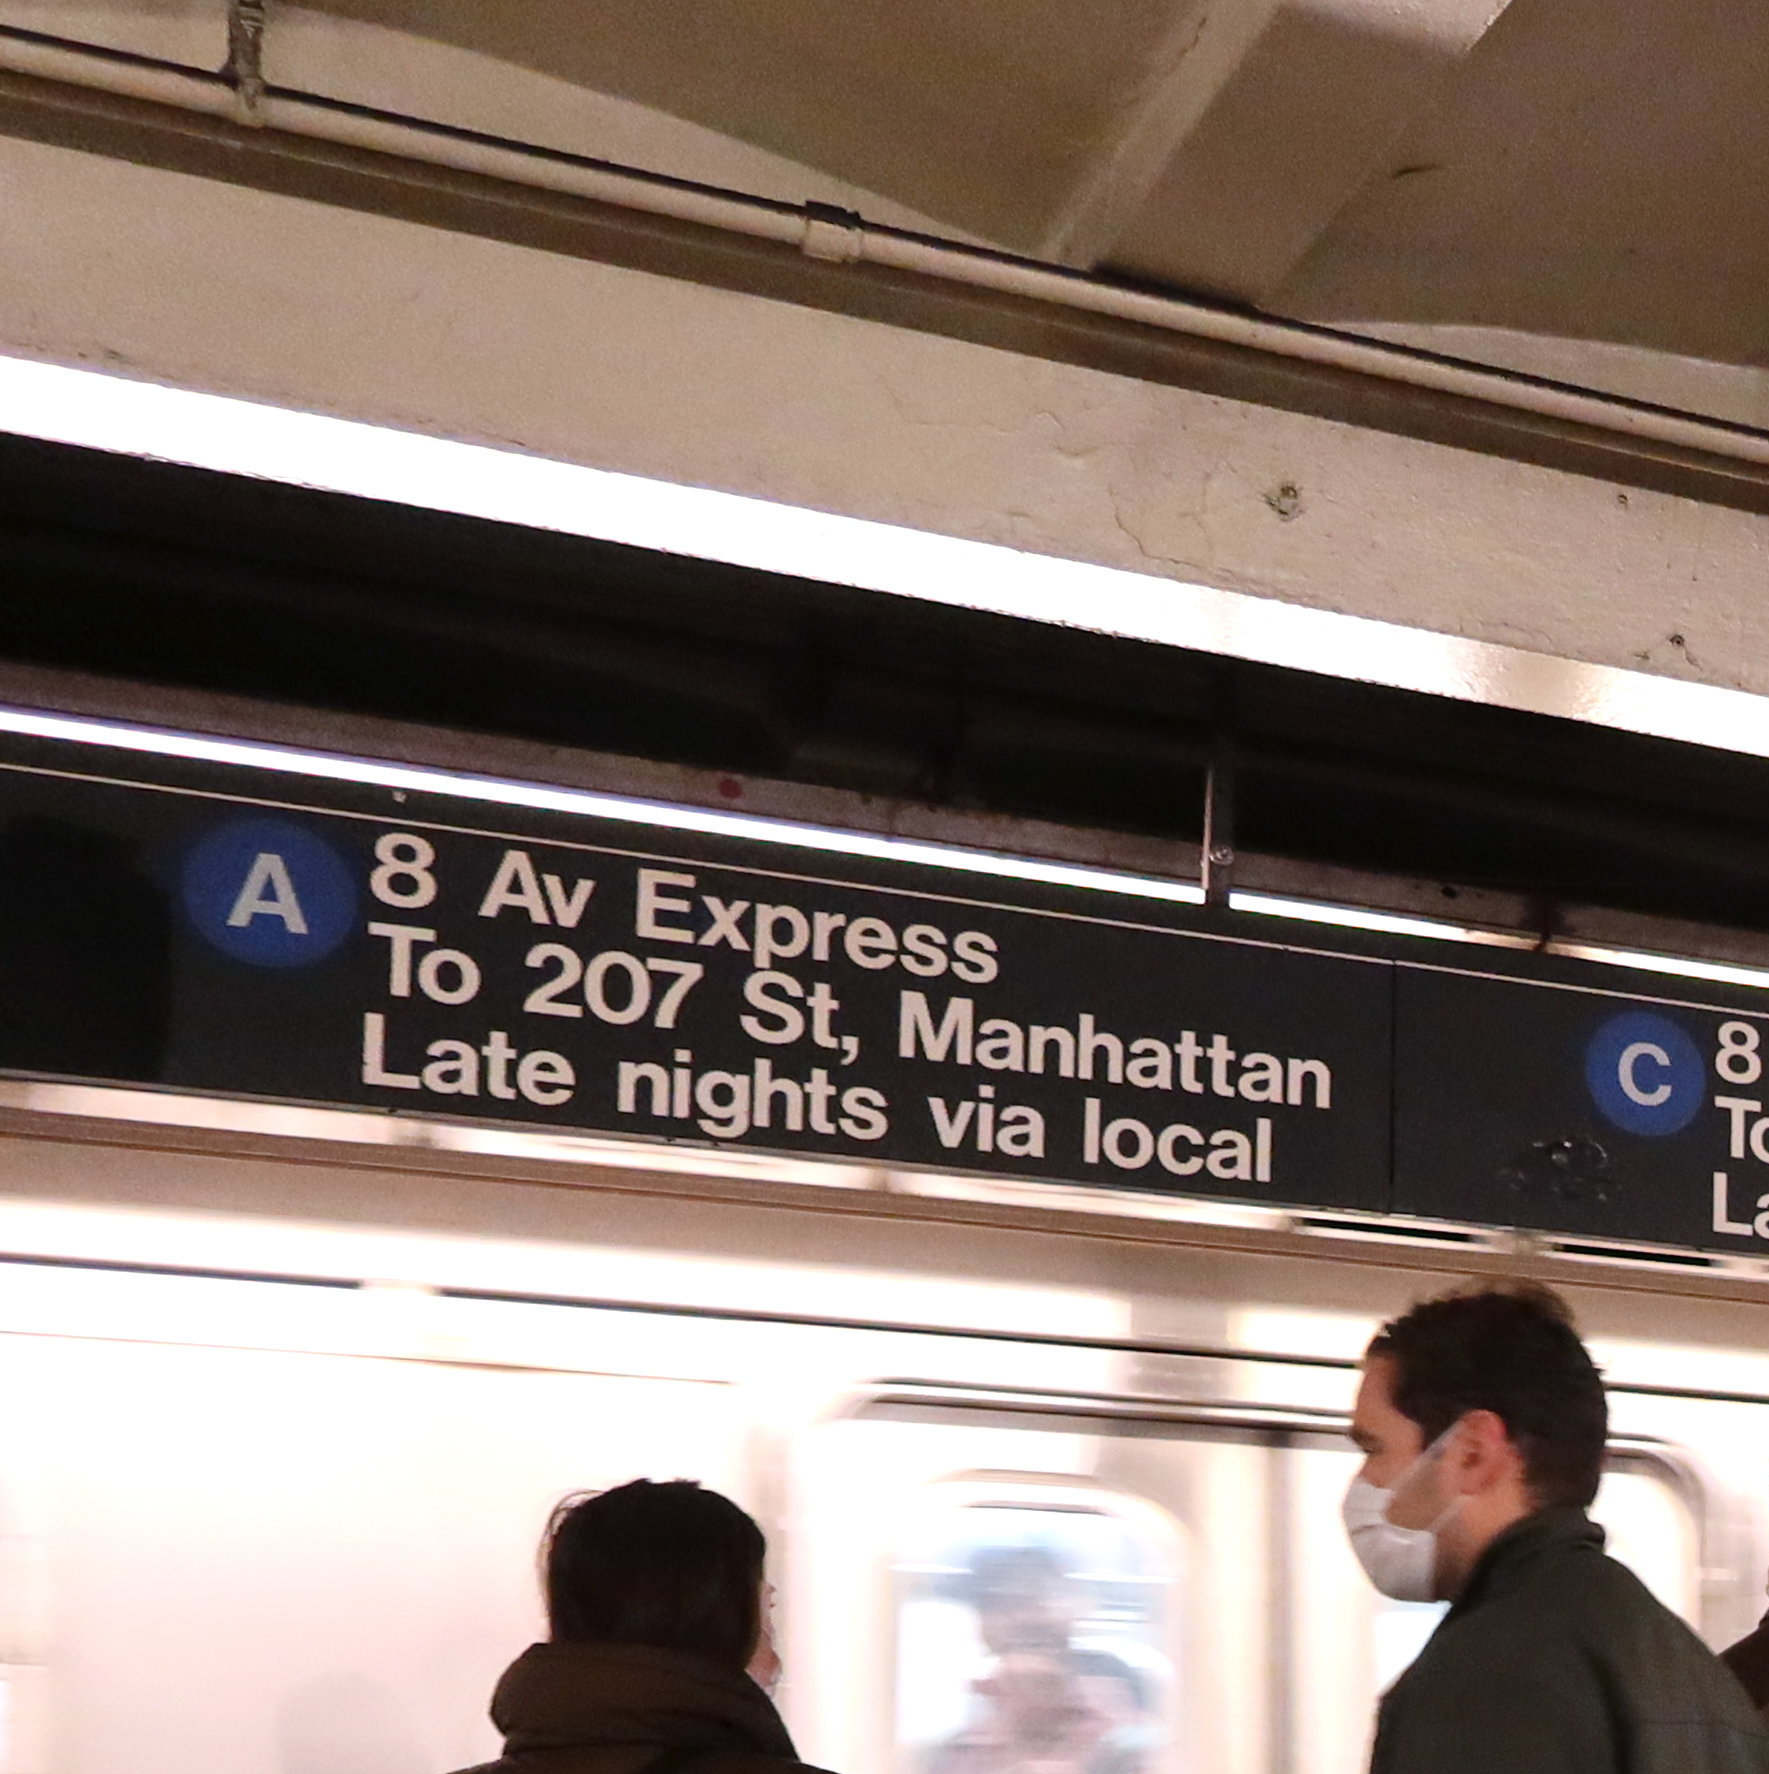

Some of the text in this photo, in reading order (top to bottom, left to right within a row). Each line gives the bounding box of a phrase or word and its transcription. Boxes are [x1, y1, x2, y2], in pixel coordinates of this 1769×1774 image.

[227, 853, 308, 934] A
[370, 832, 998, 983] 8 Av Express
[368, 921, 1332, 1109] To 207 St, Manhattan
[1714, 1021, 1762, 1084] 8
[362, 1012, 1272, 1183] Late nights via local
[1618, 1042, 1672, 1106] C
